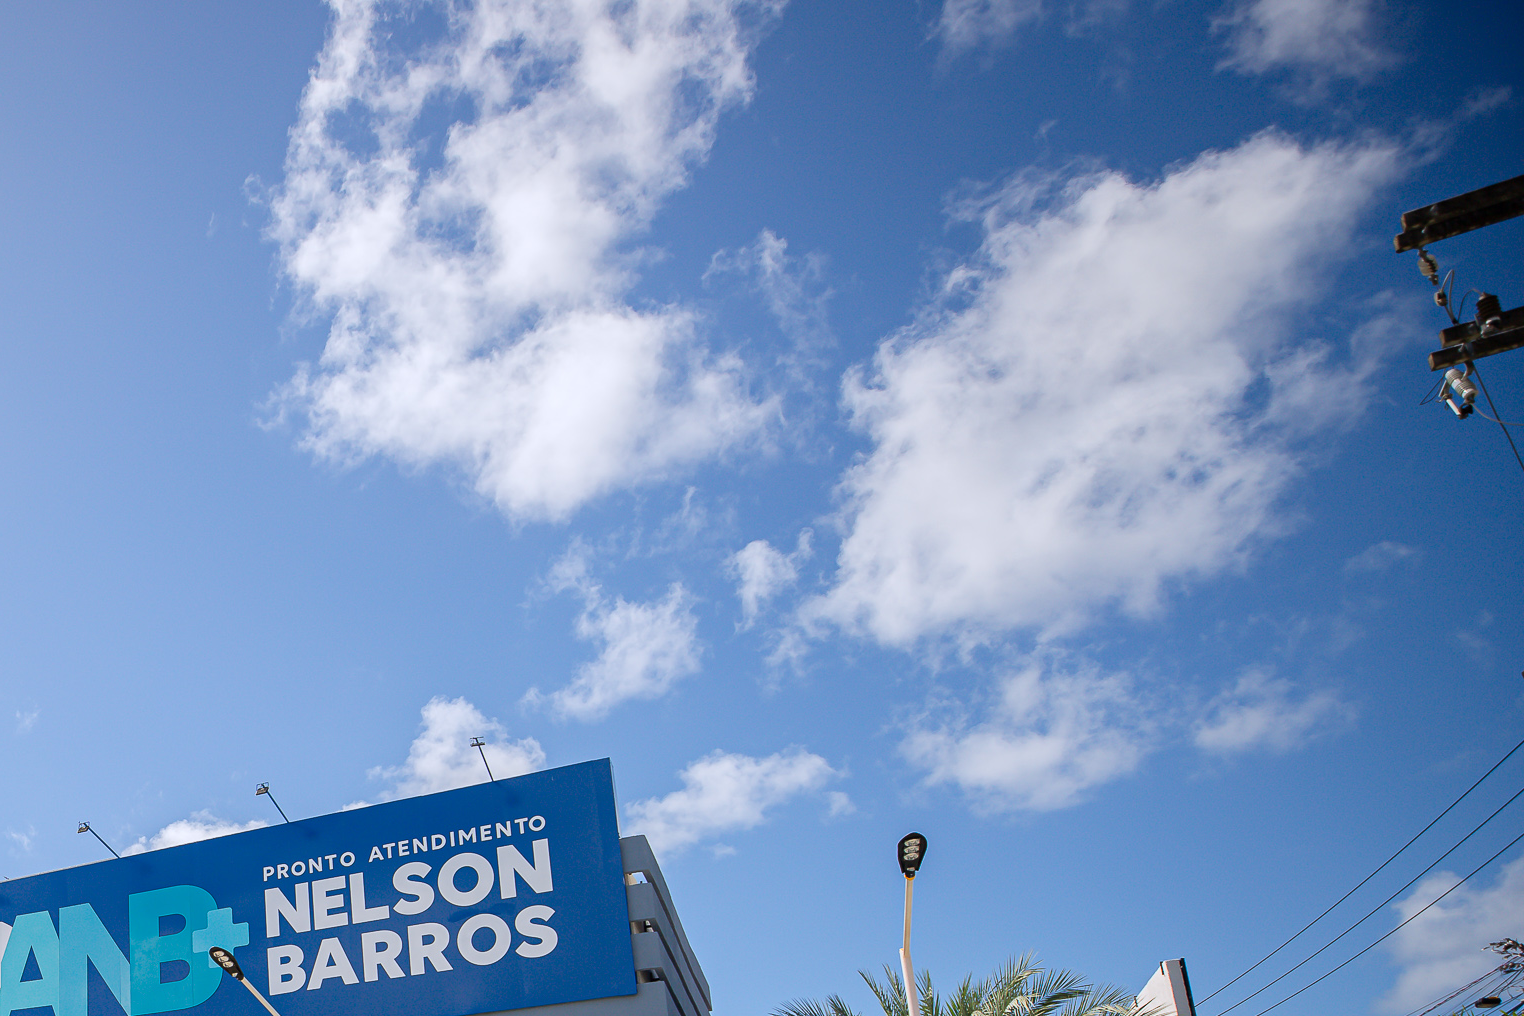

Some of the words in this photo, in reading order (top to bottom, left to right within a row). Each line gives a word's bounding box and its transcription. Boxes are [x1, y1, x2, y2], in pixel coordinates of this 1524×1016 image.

[262, 851, 356, 882] PRONTO
[368, 815, 547, 863] ATENDIMENTO
[264, 837, 554, 939] NELSON
[266, 904, 559, 996] BARROS
